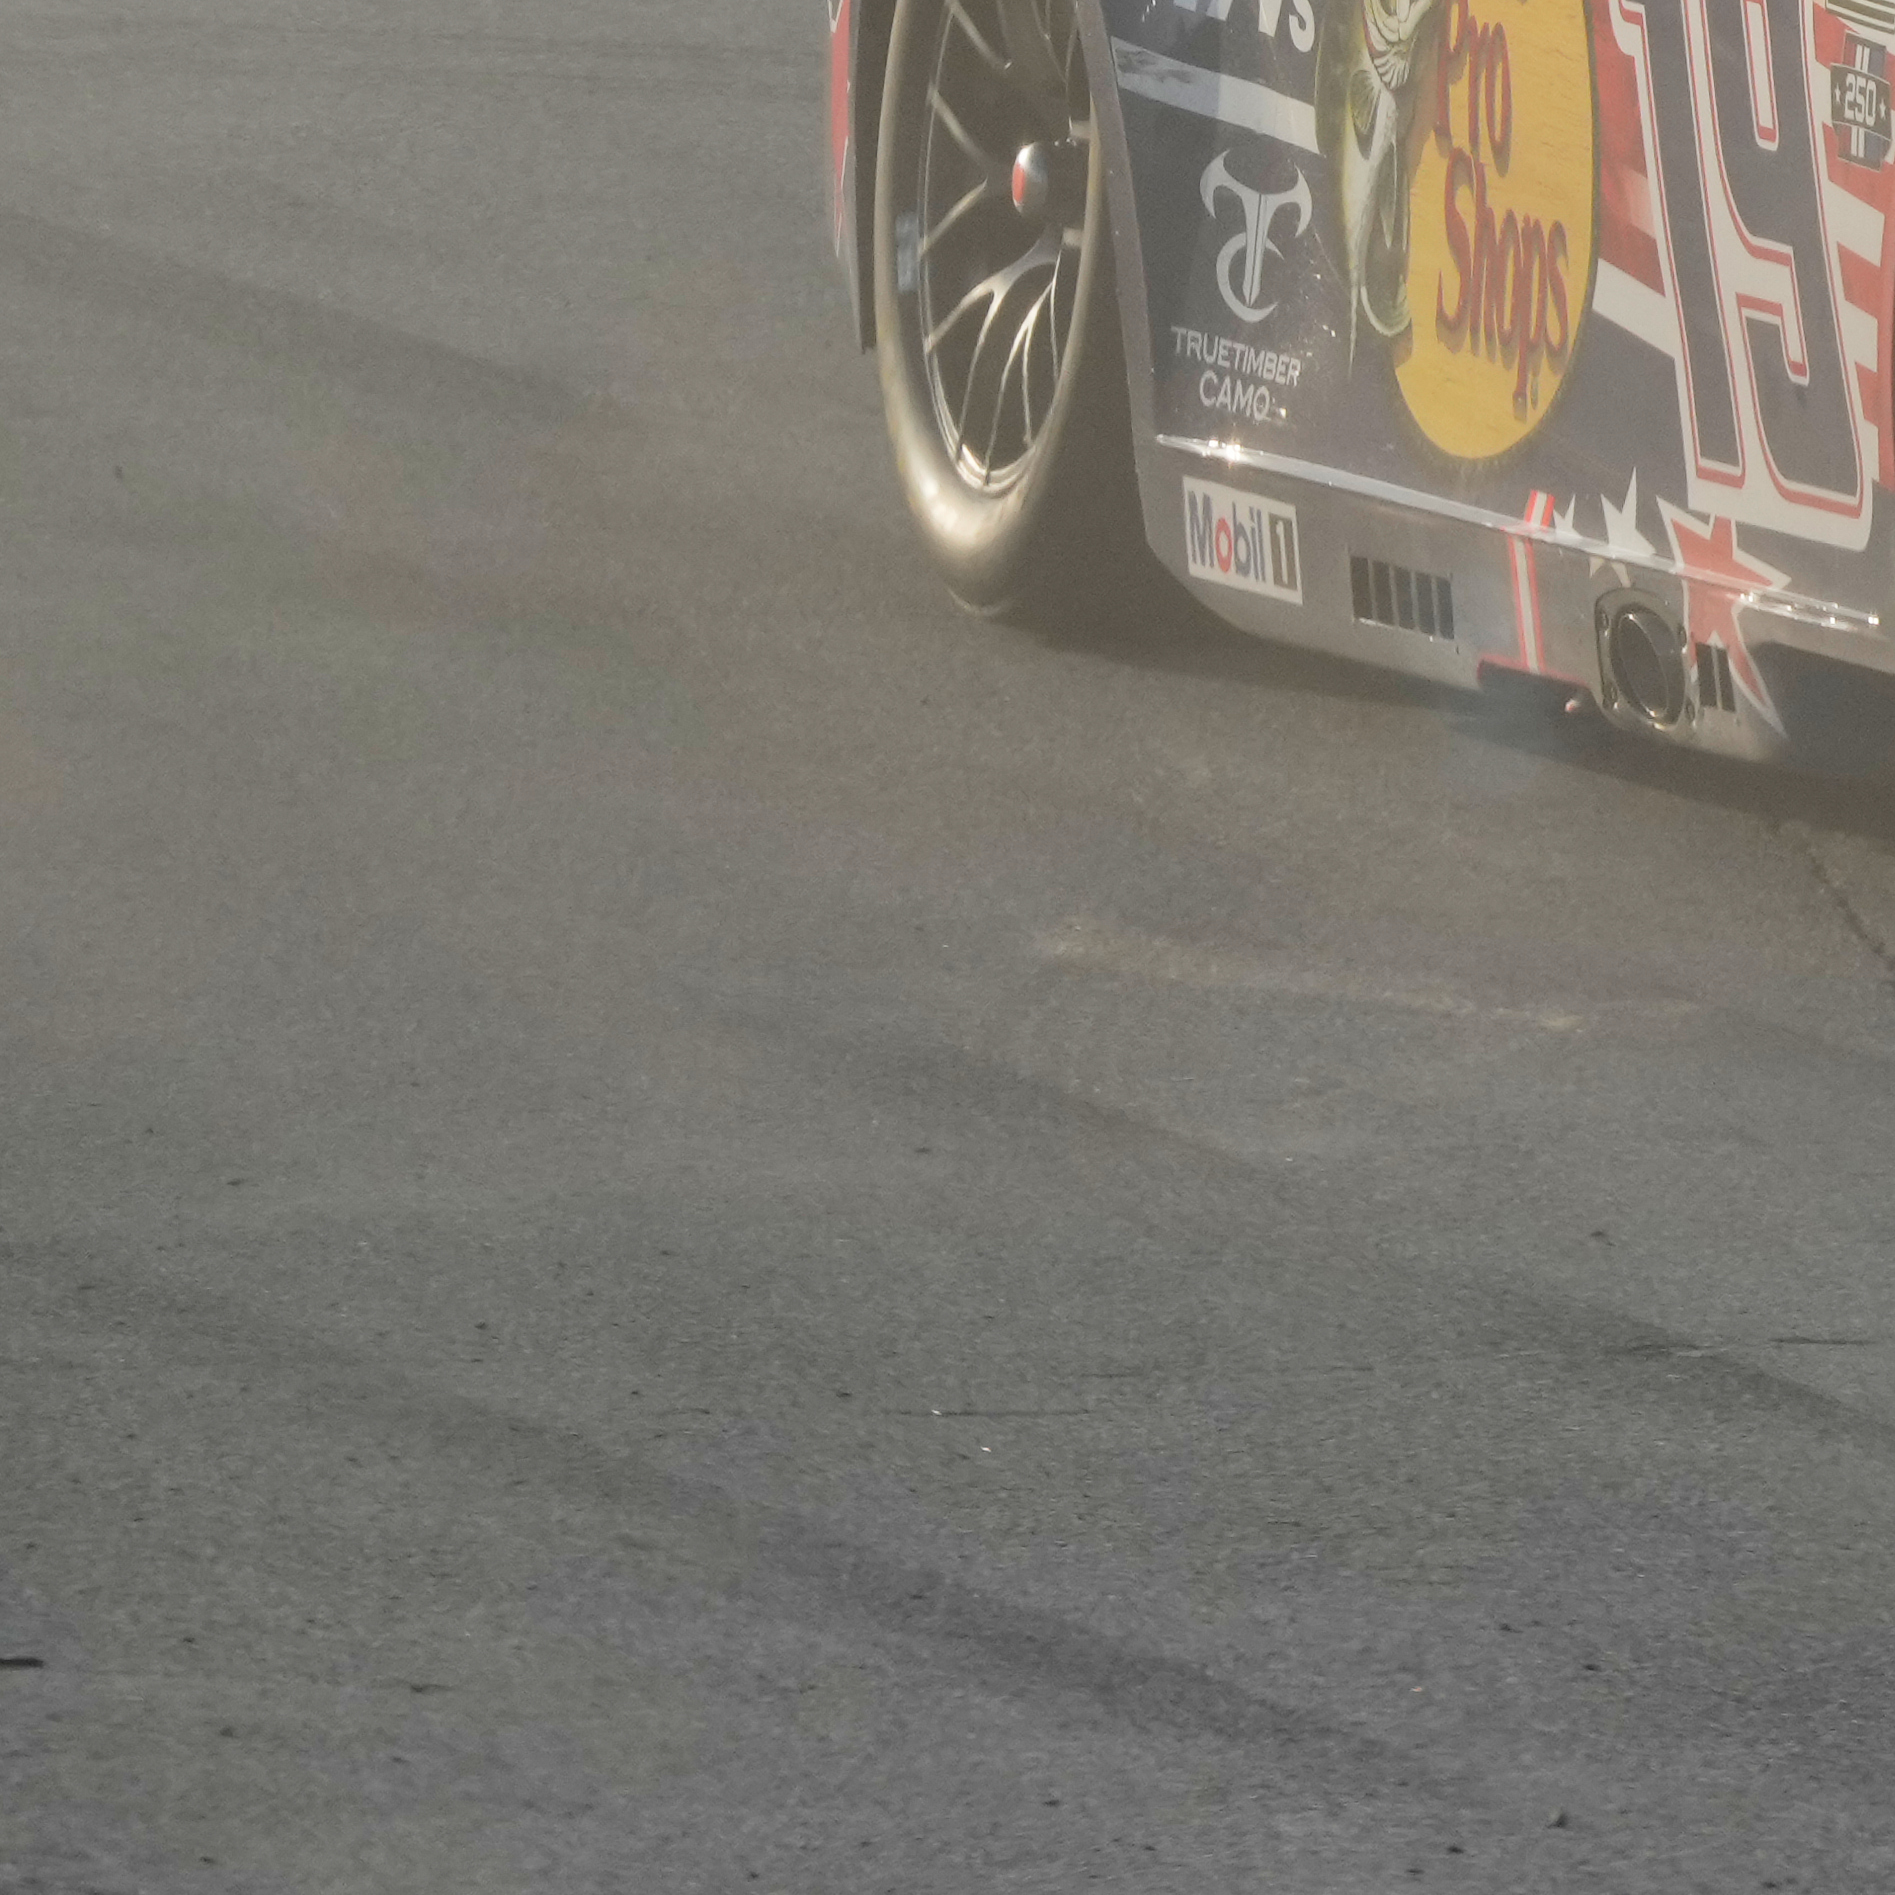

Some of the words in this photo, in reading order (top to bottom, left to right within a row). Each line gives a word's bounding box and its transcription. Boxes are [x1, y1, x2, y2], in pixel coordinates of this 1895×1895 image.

[1843, 72, 1877, 127] 250
[1435, 147, 1569, 410] Shops
[1170, 325, 1302, 388] TRUETIMBER
[1199, 369, 1272, 422] CAMO
[1187, 490, 1267, 583] Mobil
